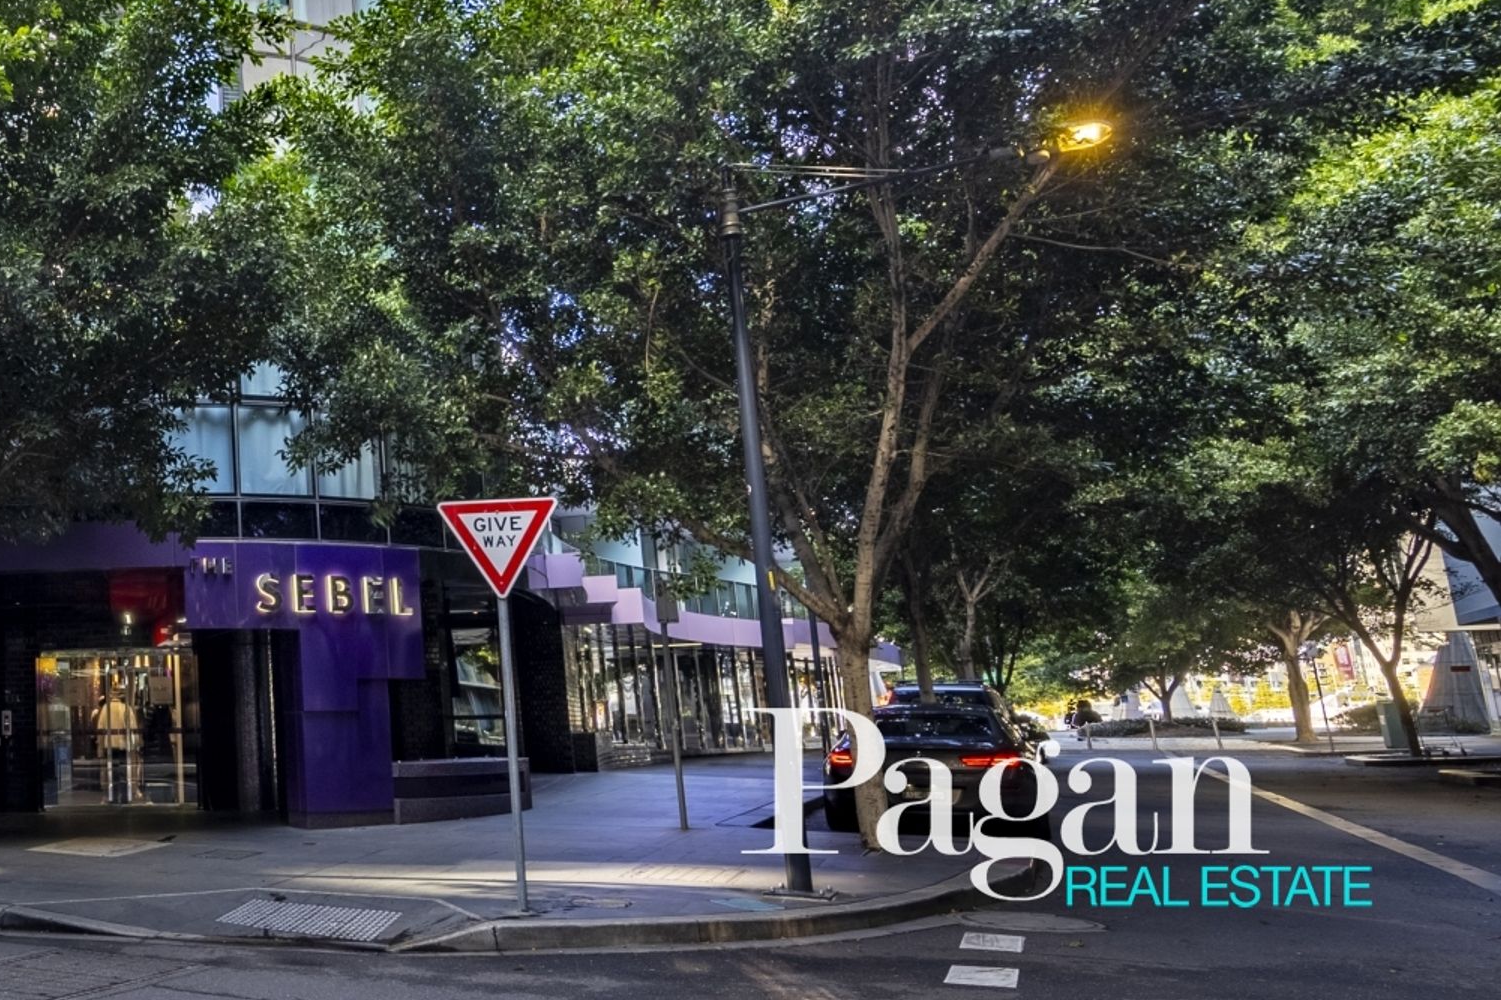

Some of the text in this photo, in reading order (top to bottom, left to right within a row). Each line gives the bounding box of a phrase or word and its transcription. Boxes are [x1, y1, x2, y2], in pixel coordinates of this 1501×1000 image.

[474, 516, 522, 532] GIVE
[483, 535, 516, 548] WAY
[190, 556, 233, 574] THE
[257, 573, 413, 616] SEBEL
